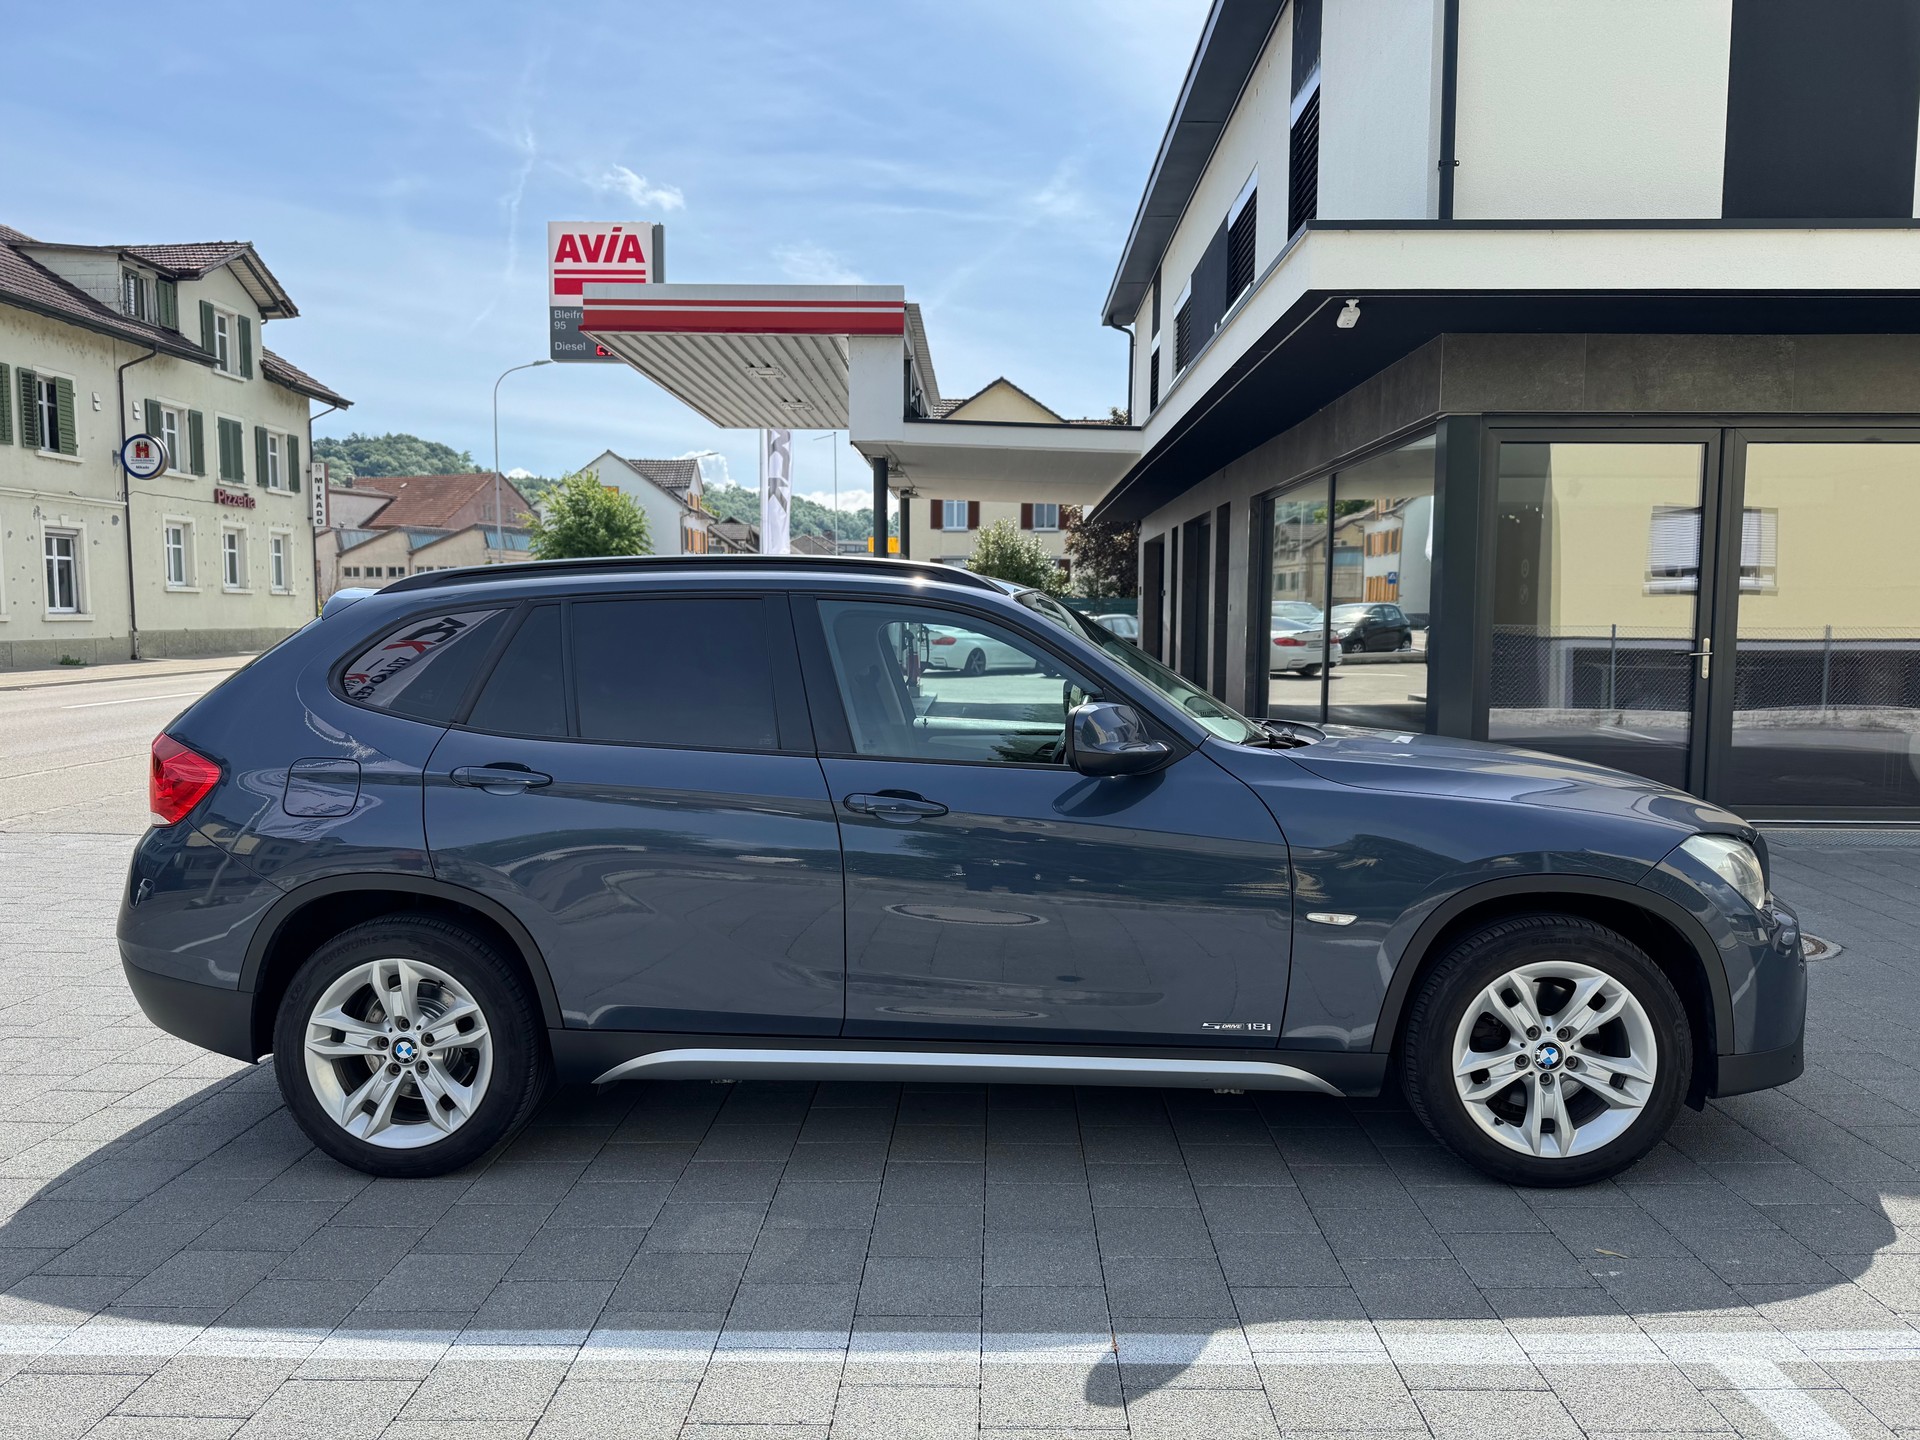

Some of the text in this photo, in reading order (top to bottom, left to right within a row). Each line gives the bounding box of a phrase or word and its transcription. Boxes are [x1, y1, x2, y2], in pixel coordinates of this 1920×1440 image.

[554, 320, 567, 330] 95
[554, 341, 586, 351] Diesel
[216, 488, 256, 509] Pizzeria
[314, 477, 323, 525] MIKADO
